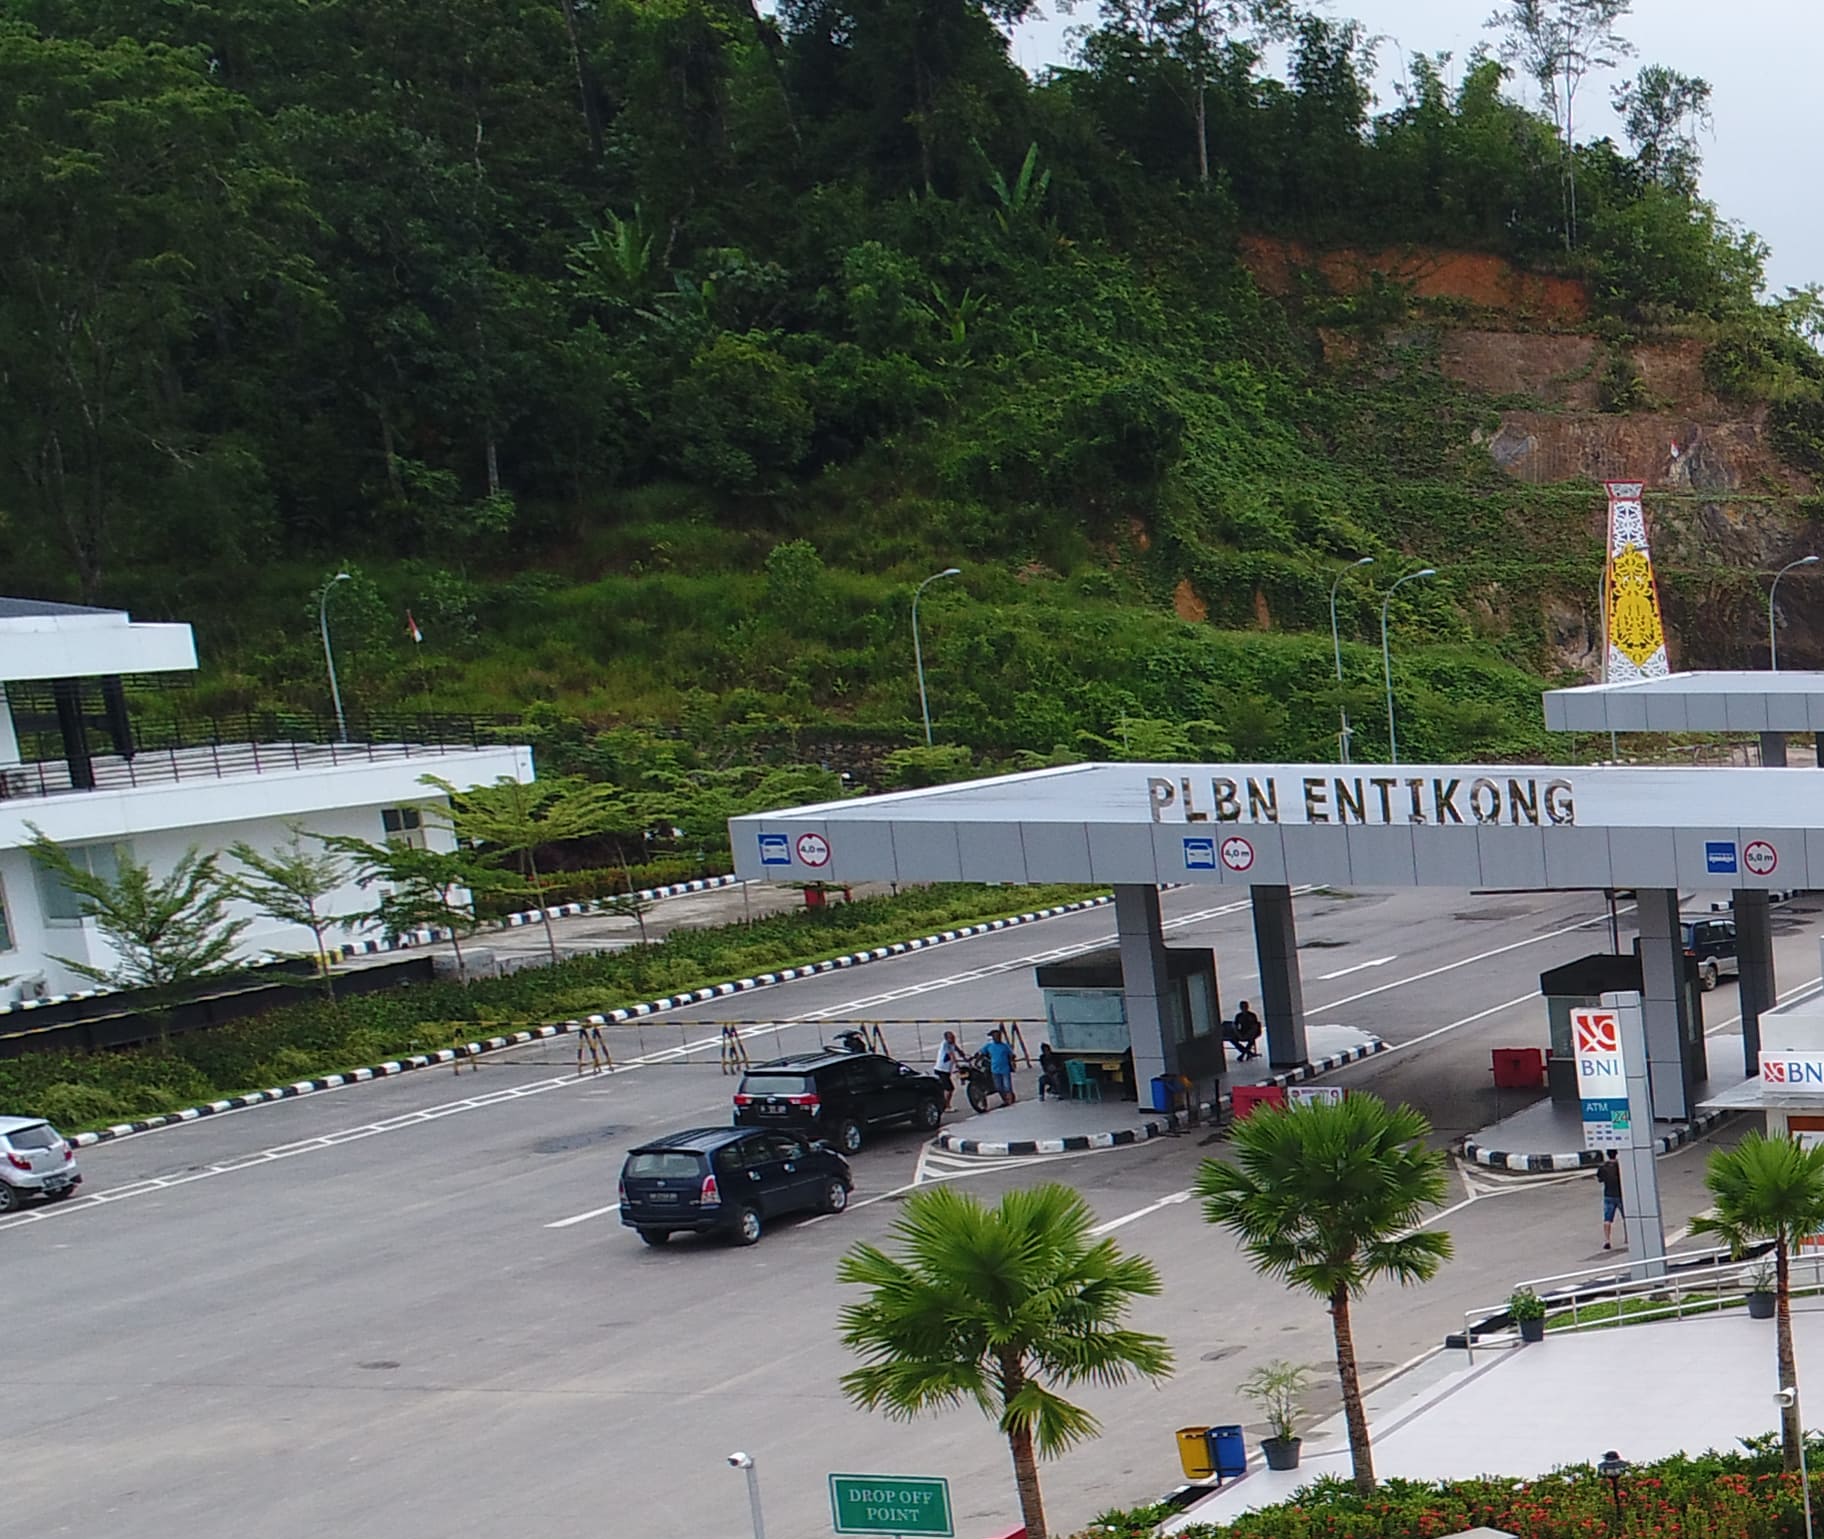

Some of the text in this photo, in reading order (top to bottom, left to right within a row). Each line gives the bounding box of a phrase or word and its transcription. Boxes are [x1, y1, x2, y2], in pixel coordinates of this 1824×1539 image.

[1147, 777, 1576, 826] PLBN ENTIKONG
[1581, 1059, 1619, 1077] BNI
[1586, 1102, 1609, 1112] ATM
[848, 1488, 933, 1504] DROP OFF
[866, 1507, 920, 1522] POINT
